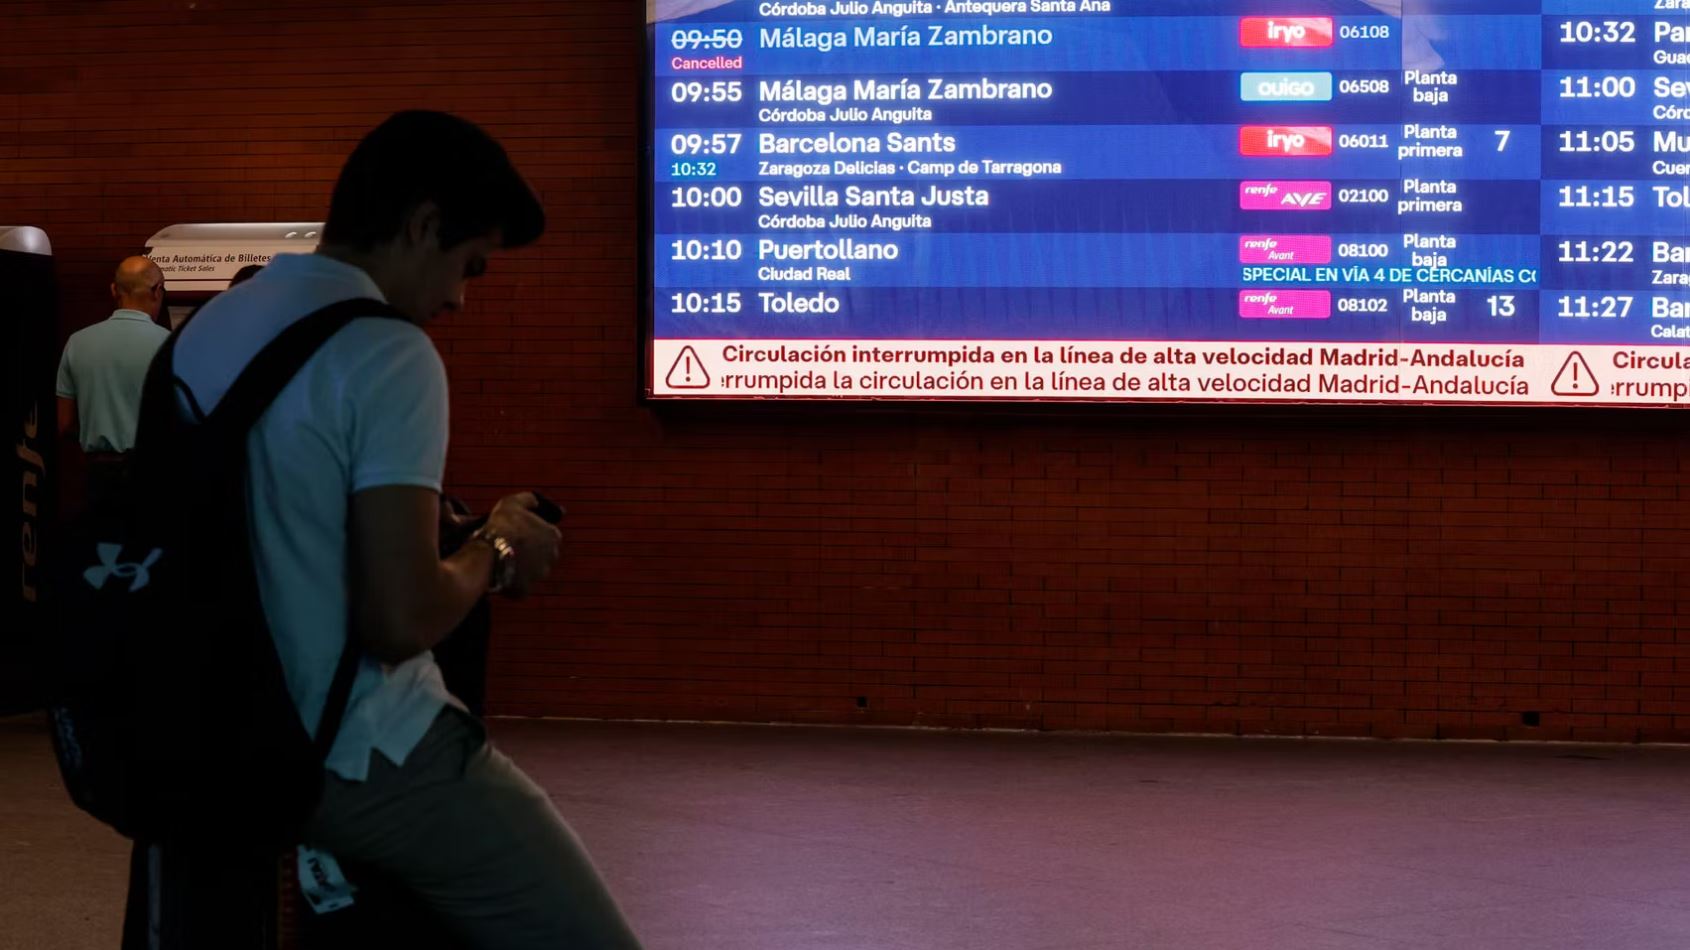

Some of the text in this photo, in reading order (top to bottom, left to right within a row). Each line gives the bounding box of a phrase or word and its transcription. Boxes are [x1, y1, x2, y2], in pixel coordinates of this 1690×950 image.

[760, 0, 1110, 17] Córdoba Julio Anguita Antequera Santa Ana
[672, 30, 742, 49] 09:50
[761, 25, 1052, 51] Málaga María Zambrano
[1268, 21, 1305, 42] iryo
[1340, 26, 1388, 38] 06108
[1561, 22, 1635, 42] 10:32
[672, 57, 742, 69] Cancelled
[1405, 70, 1457, 84] Planta
[672, 82, 742, 102] 09:55
[760, 78, 1052, 105] Málaga María Zambrano
[1340, 80, 1389, 93] 06508
[1561, 77, 1635, 97] 11:00
[1414, 88, 1448, 105] baja
[759, 107, 932, 123] Córdoba Julio Anguita
[1405, 124, 1457, 138] Planta
[672, 134, 741, 154] 09:57
[760, 132, 955, 153] Barcelona Sants
[1268, 130, 1305, 151] iryo
[1339, 135, 1388, 147] 06011
[1495, 131, 1510, 151] 7
[1560, 131, 1634, 151] 11:05
[1399, 142, 1462, 160] primera
[672, 163, 715, 175] 10:32
[759, 160, 1061, 177] Zaragoza Delicias Camp de Tarragona
[1404, 179, 1456, 193] Planta
[672, 187, 741, 207] 10:00
[759, 186, 988, 206] Sevilla Santa Justa
[1281, 192, 1326, 207] AVE
[1339, 189, 1388, 202] 02100
[1560, 186, 1634, 207] 11:15
[1398, 197, 1462, 214] primera
[759, 214, 931, 230] Córdoba Julio Anguita
[672, 240, 741, 259] 10:10
[760, 239, 898, 259] Puertollano
[1404, 234, 1456, 248] Planta
[172, 254, 222, 263] Automática
[224, 254, 235, 263] de
[238, 253, 271, 262] Billetes
[1267, 250, 1294, 260] Avant
[1339, 244, 1388, 257] 08100
[1559, 241, 1633, 262] 11:22
[1412, 252, 1447, 269] baja
[759, 267, 850, 280] Ciudad Real
[1316, 268, 1337, 281] EN
[1342, 267, 1369, 281] VÍA
[1374, 268, 1385, 281] 4
[1390, 268, 1412, 282] DE
[1417, 267, 1514, 282] CERCANÍAS
[1652, 270, 1690, 286] Zara
[672, 293, 741, 312] 10:15
[759, 292, 839, 312] Toledo
[1404, 289, 1455, 303] Planta
[1267, 304, 1294, 314] Avant
[1338, 299, 1387, 311] 08102
[1488, 296, 1515, 316] 13
[1559, 296, 1633, 317] 11:27
[1412, 307, 1446, 324] baja
[723, 345, 1524, 367] Circulación interrumpida en la línea de alta velocidad Madrid-Andalucía
[722, 371, 1528, 395] rrumpida la circulación en la línea de alta velocidad Madrid-Andalucía
[1611, 381, 1690, 401] rrump
